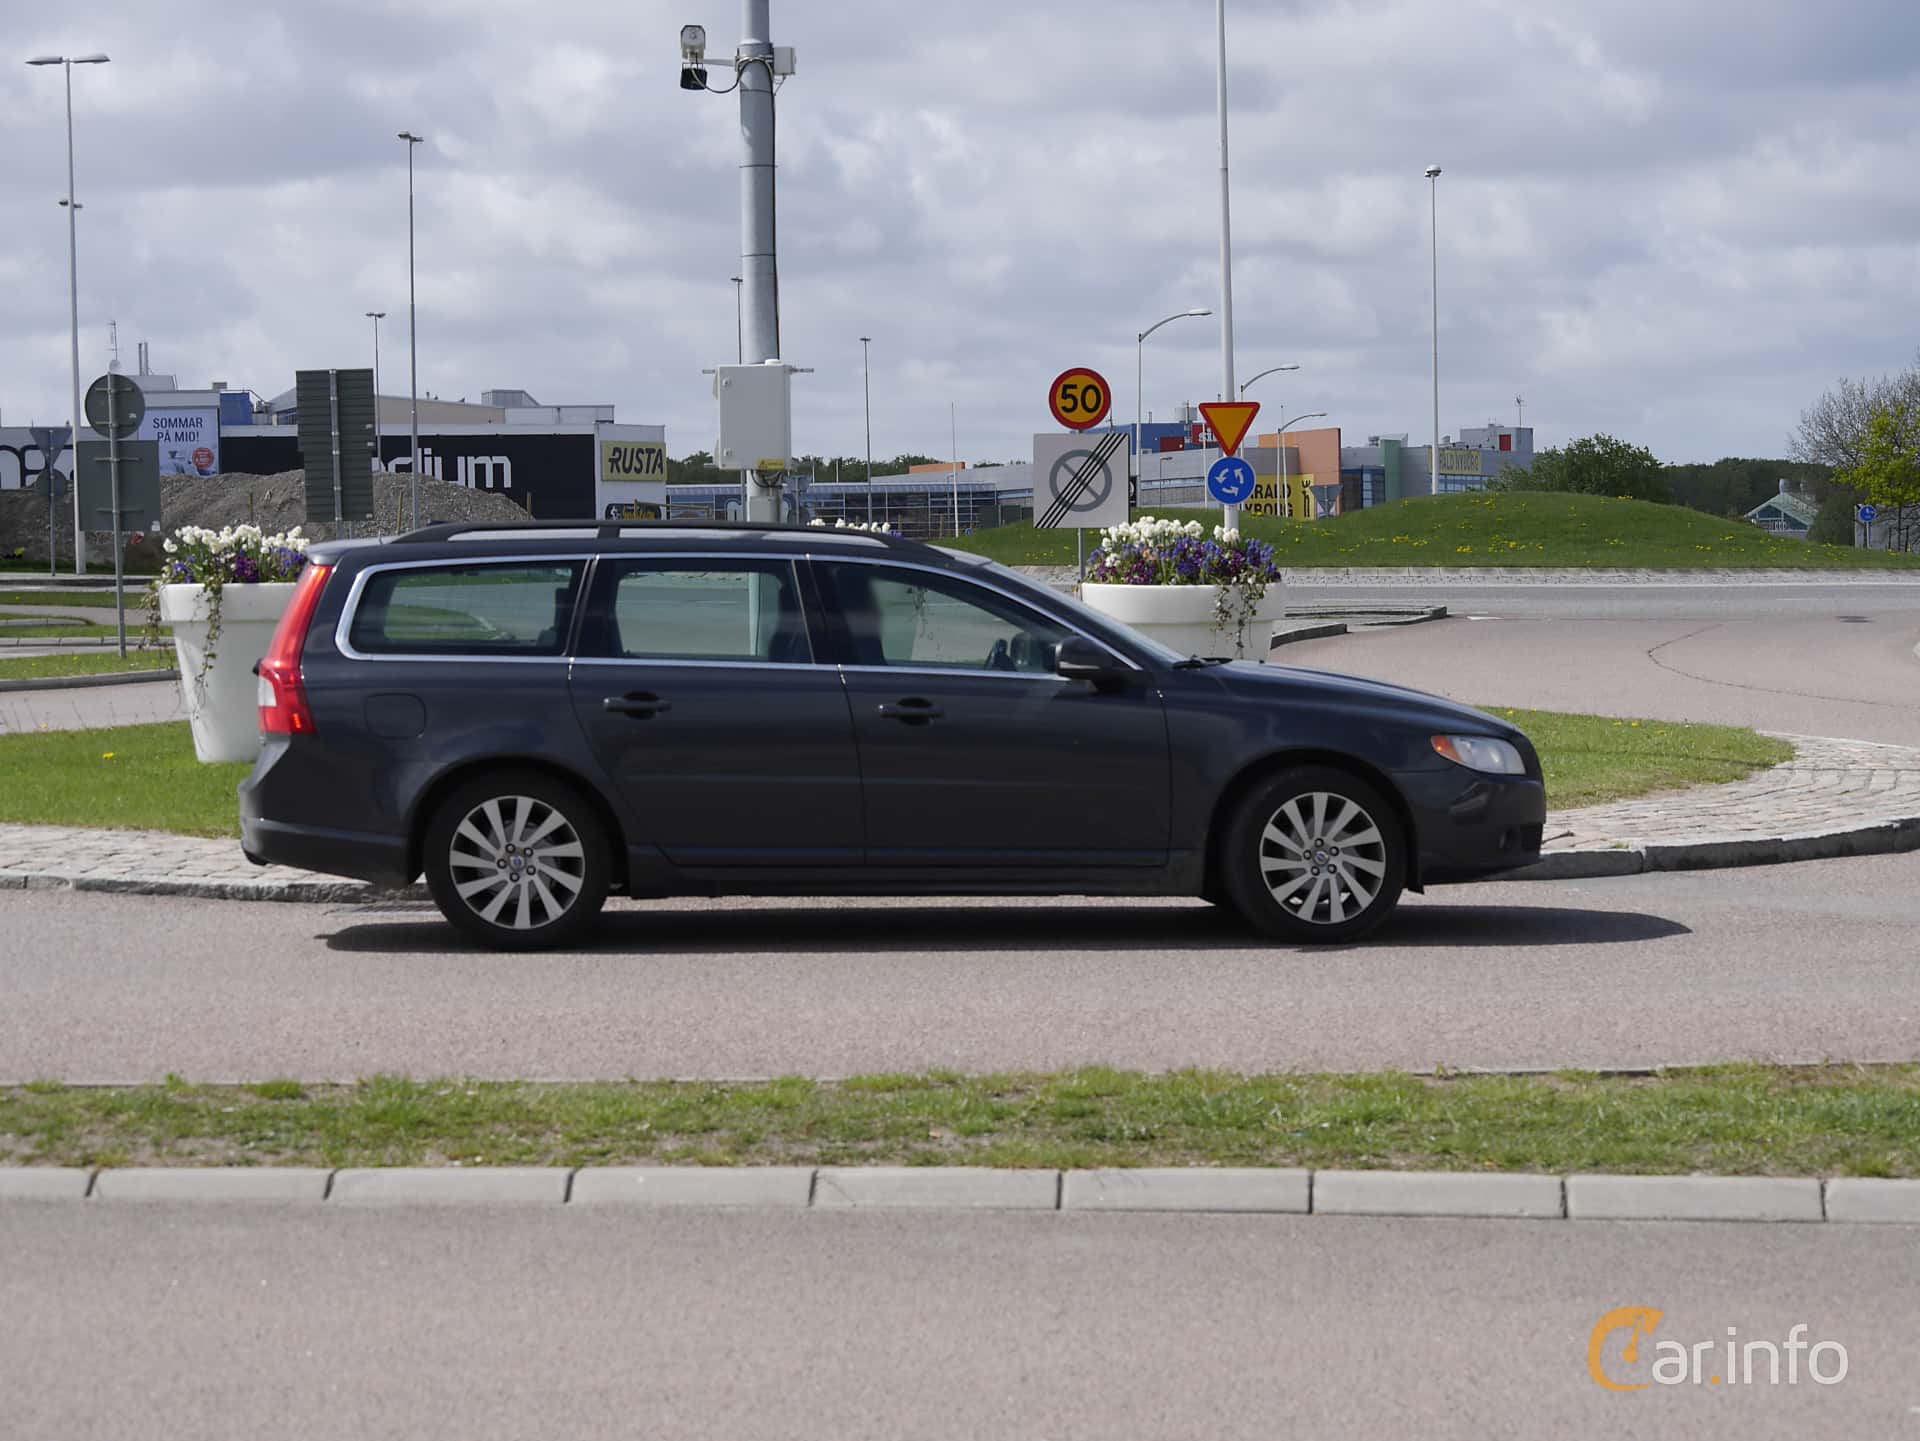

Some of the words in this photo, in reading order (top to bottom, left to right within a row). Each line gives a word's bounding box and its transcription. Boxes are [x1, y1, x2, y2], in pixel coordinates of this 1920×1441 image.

[1061, 384, 1102, 413] 50
[152, 417, 204, 429] SOMMAR
[157, 429, 171, 442] PÅ
[174, 431, 199, 442] MIO!
[608, 447, 664, 474] RUSTA
